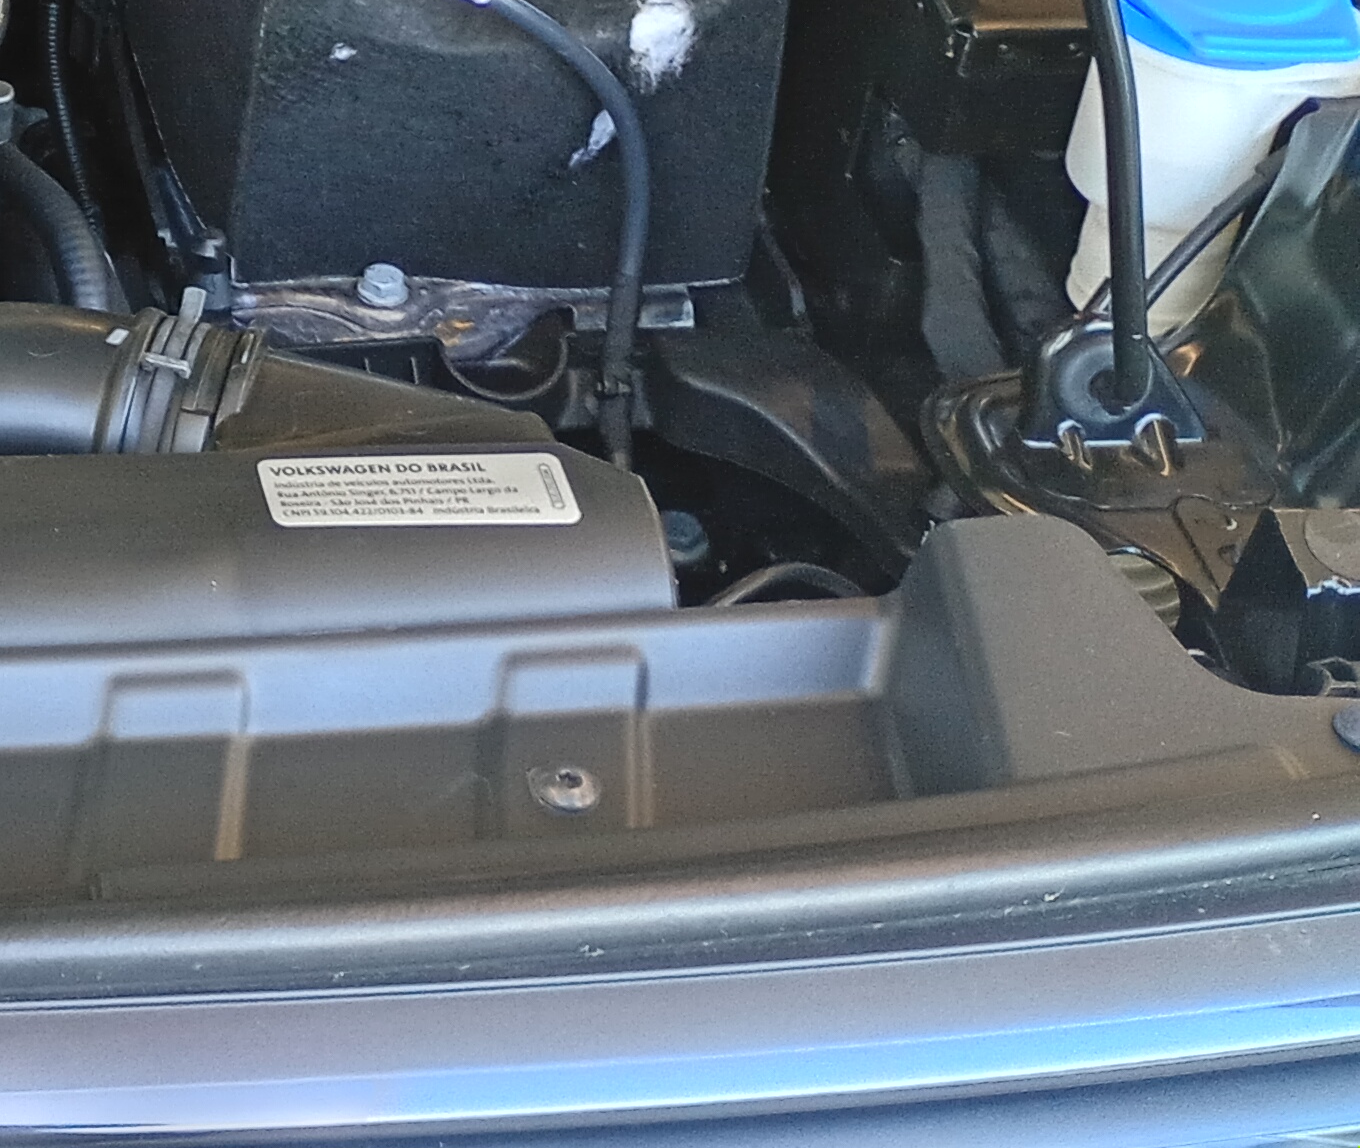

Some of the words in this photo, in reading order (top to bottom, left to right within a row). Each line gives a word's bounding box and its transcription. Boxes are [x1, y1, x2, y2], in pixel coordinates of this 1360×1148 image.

[269, 464, 391, 476] VOLKSWAGEN
[395, 463, 422, 473] DO
[427, 462, 486, 473] BRASIL
